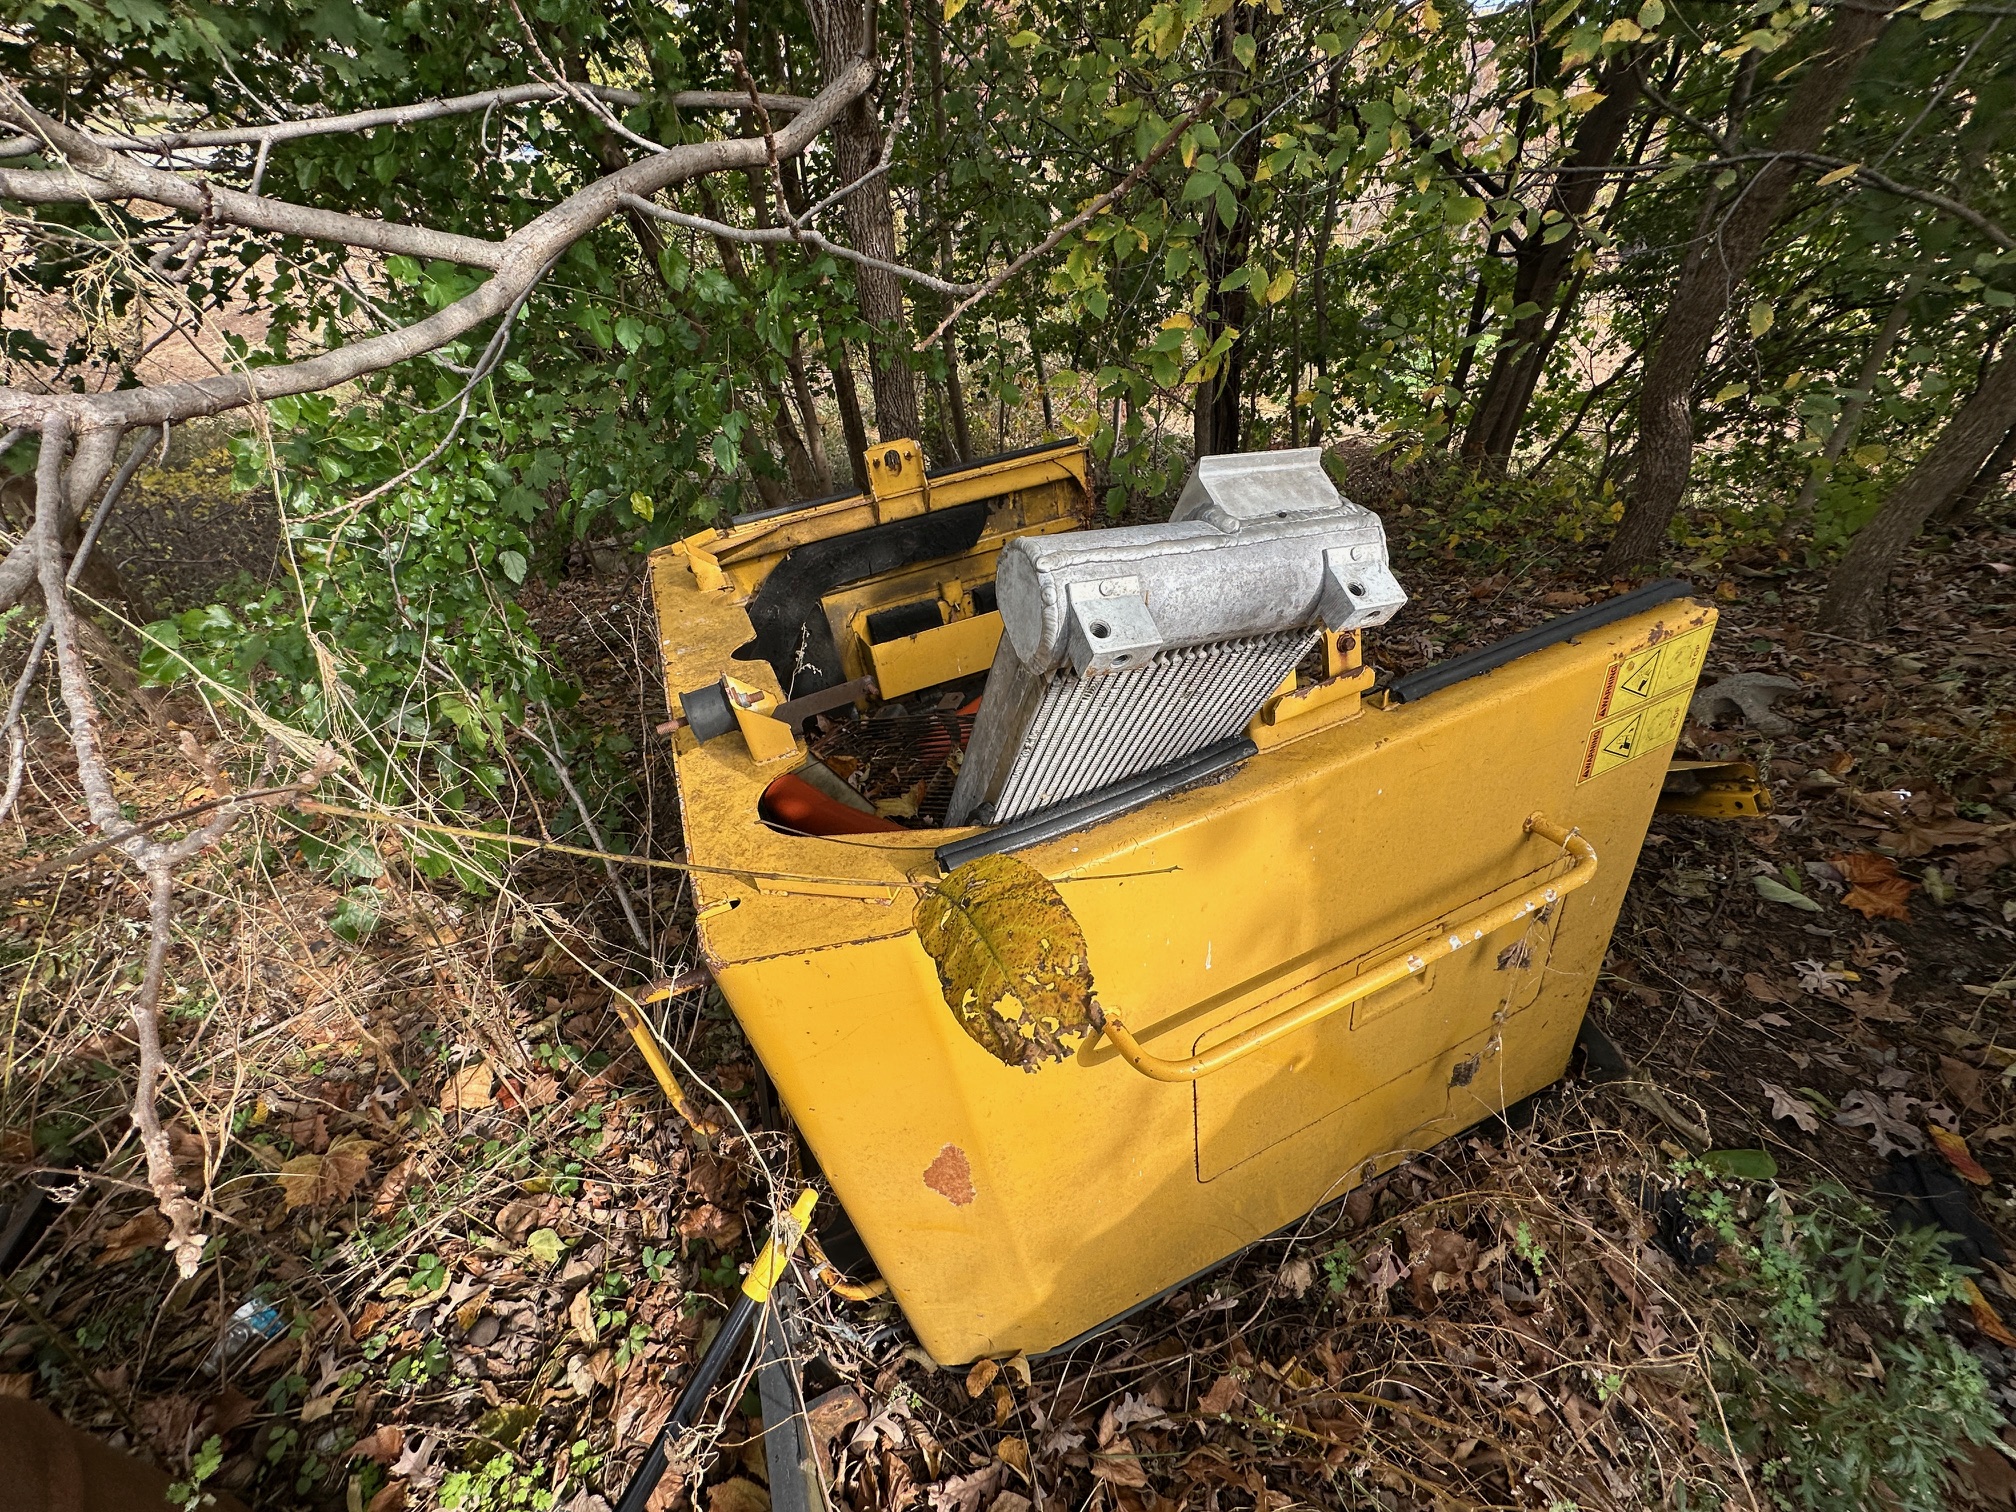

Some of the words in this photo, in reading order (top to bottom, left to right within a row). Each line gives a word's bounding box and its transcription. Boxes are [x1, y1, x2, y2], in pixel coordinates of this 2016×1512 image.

[1690, 644, 1700, 668] STOP
[1600, 665, 1618, 710] WARNING
[1670, 707, 1680, 729] STOP
[1584, 730, 1600, 773] WARNING
